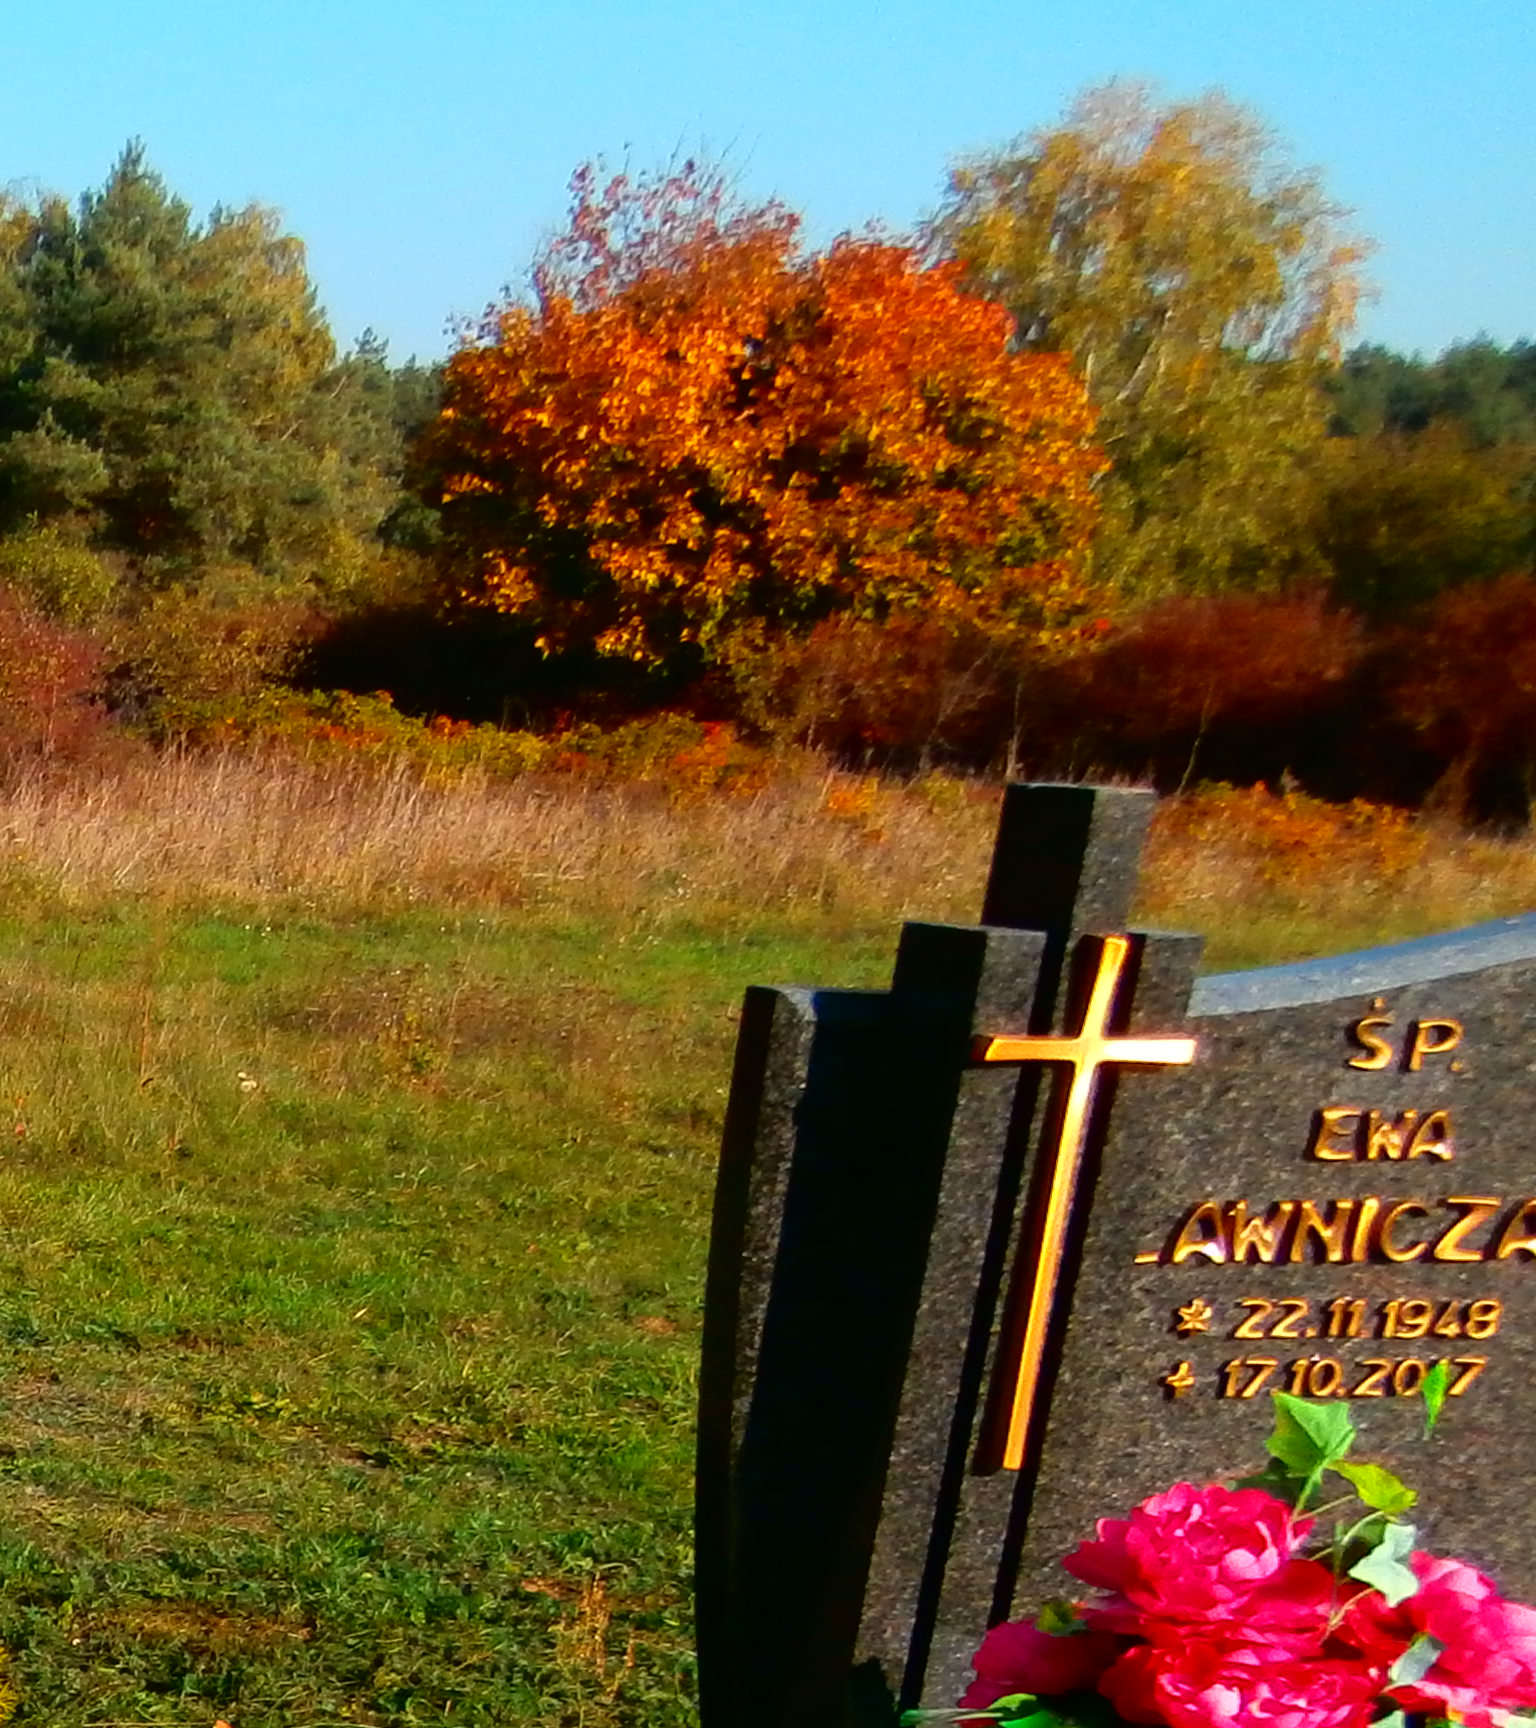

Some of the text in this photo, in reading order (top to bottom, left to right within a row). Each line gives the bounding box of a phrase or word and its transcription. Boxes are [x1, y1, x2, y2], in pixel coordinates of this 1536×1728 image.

[1313, 1104, 1455, 1161] EWA
[1132, 1195, 1536, 1264] AWNICZA
[1233, 1297, 1503, 1339] 22.11.1948
[1224, 1355, 1488, 1398] 17.10.207
